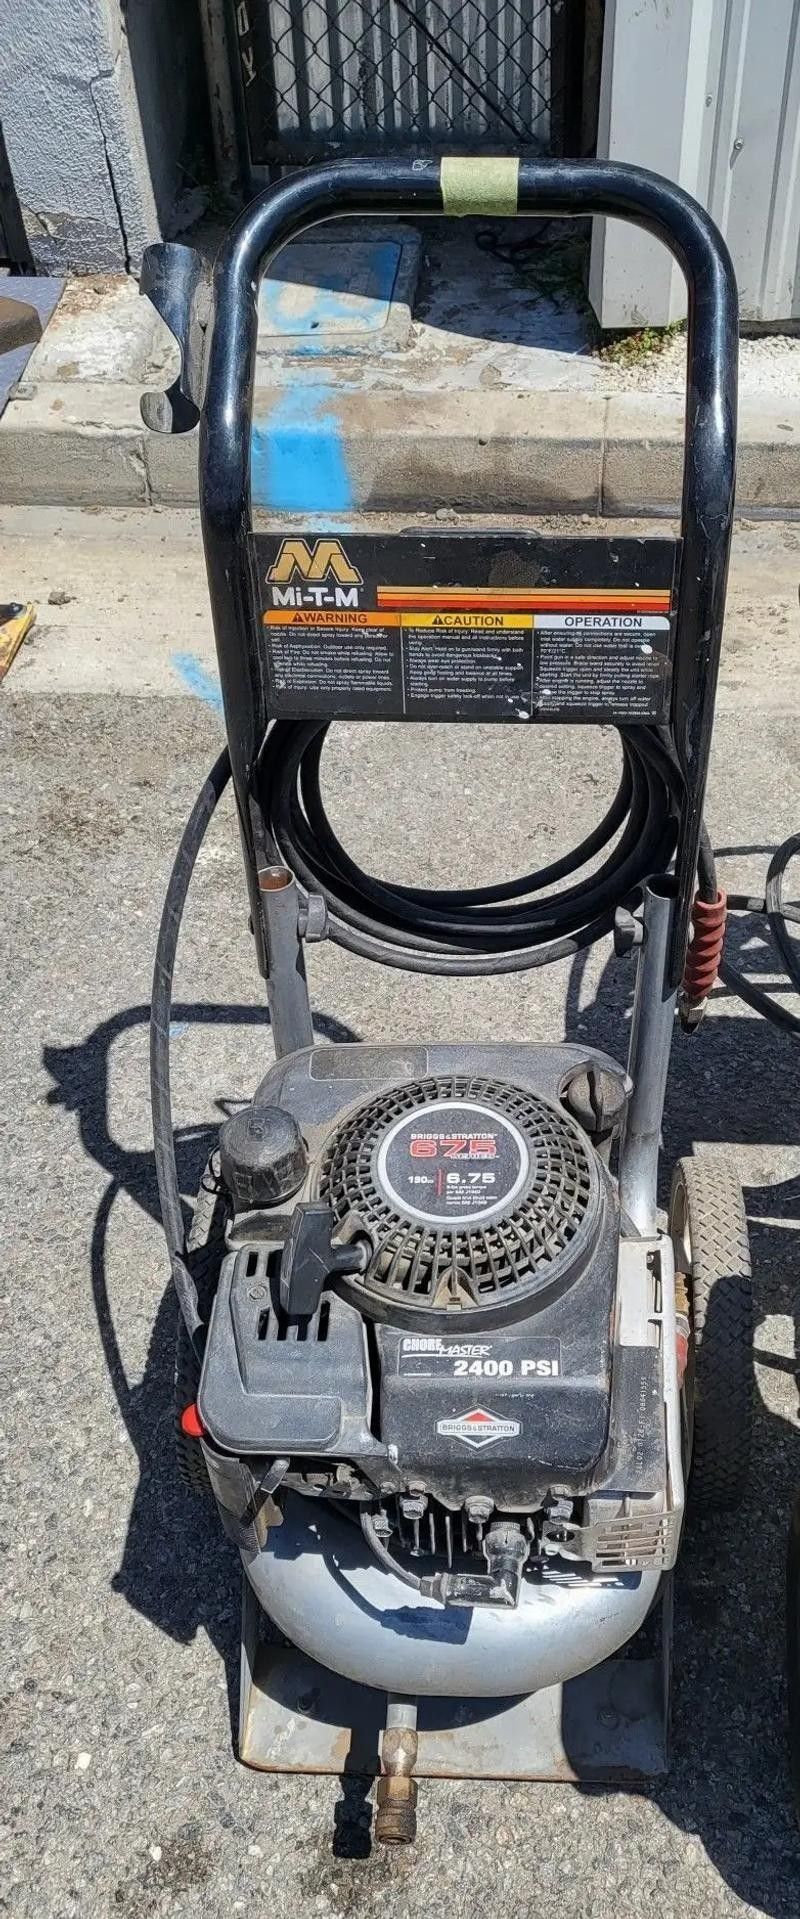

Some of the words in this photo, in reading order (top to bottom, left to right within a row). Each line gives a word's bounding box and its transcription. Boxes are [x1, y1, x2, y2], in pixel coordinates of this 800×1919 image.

[303, 612, 368, 624] WARNING
[444, 615, 504, 626] CAUTION
[564, 616, 643, 628] OPERATION
[410, 1140, 497, 1158] 675
[446, 1172, 496, 1184] 6.75
[453, 1360, 513, 1377] 2400
[520, 1360, 559, 1376] PSI
